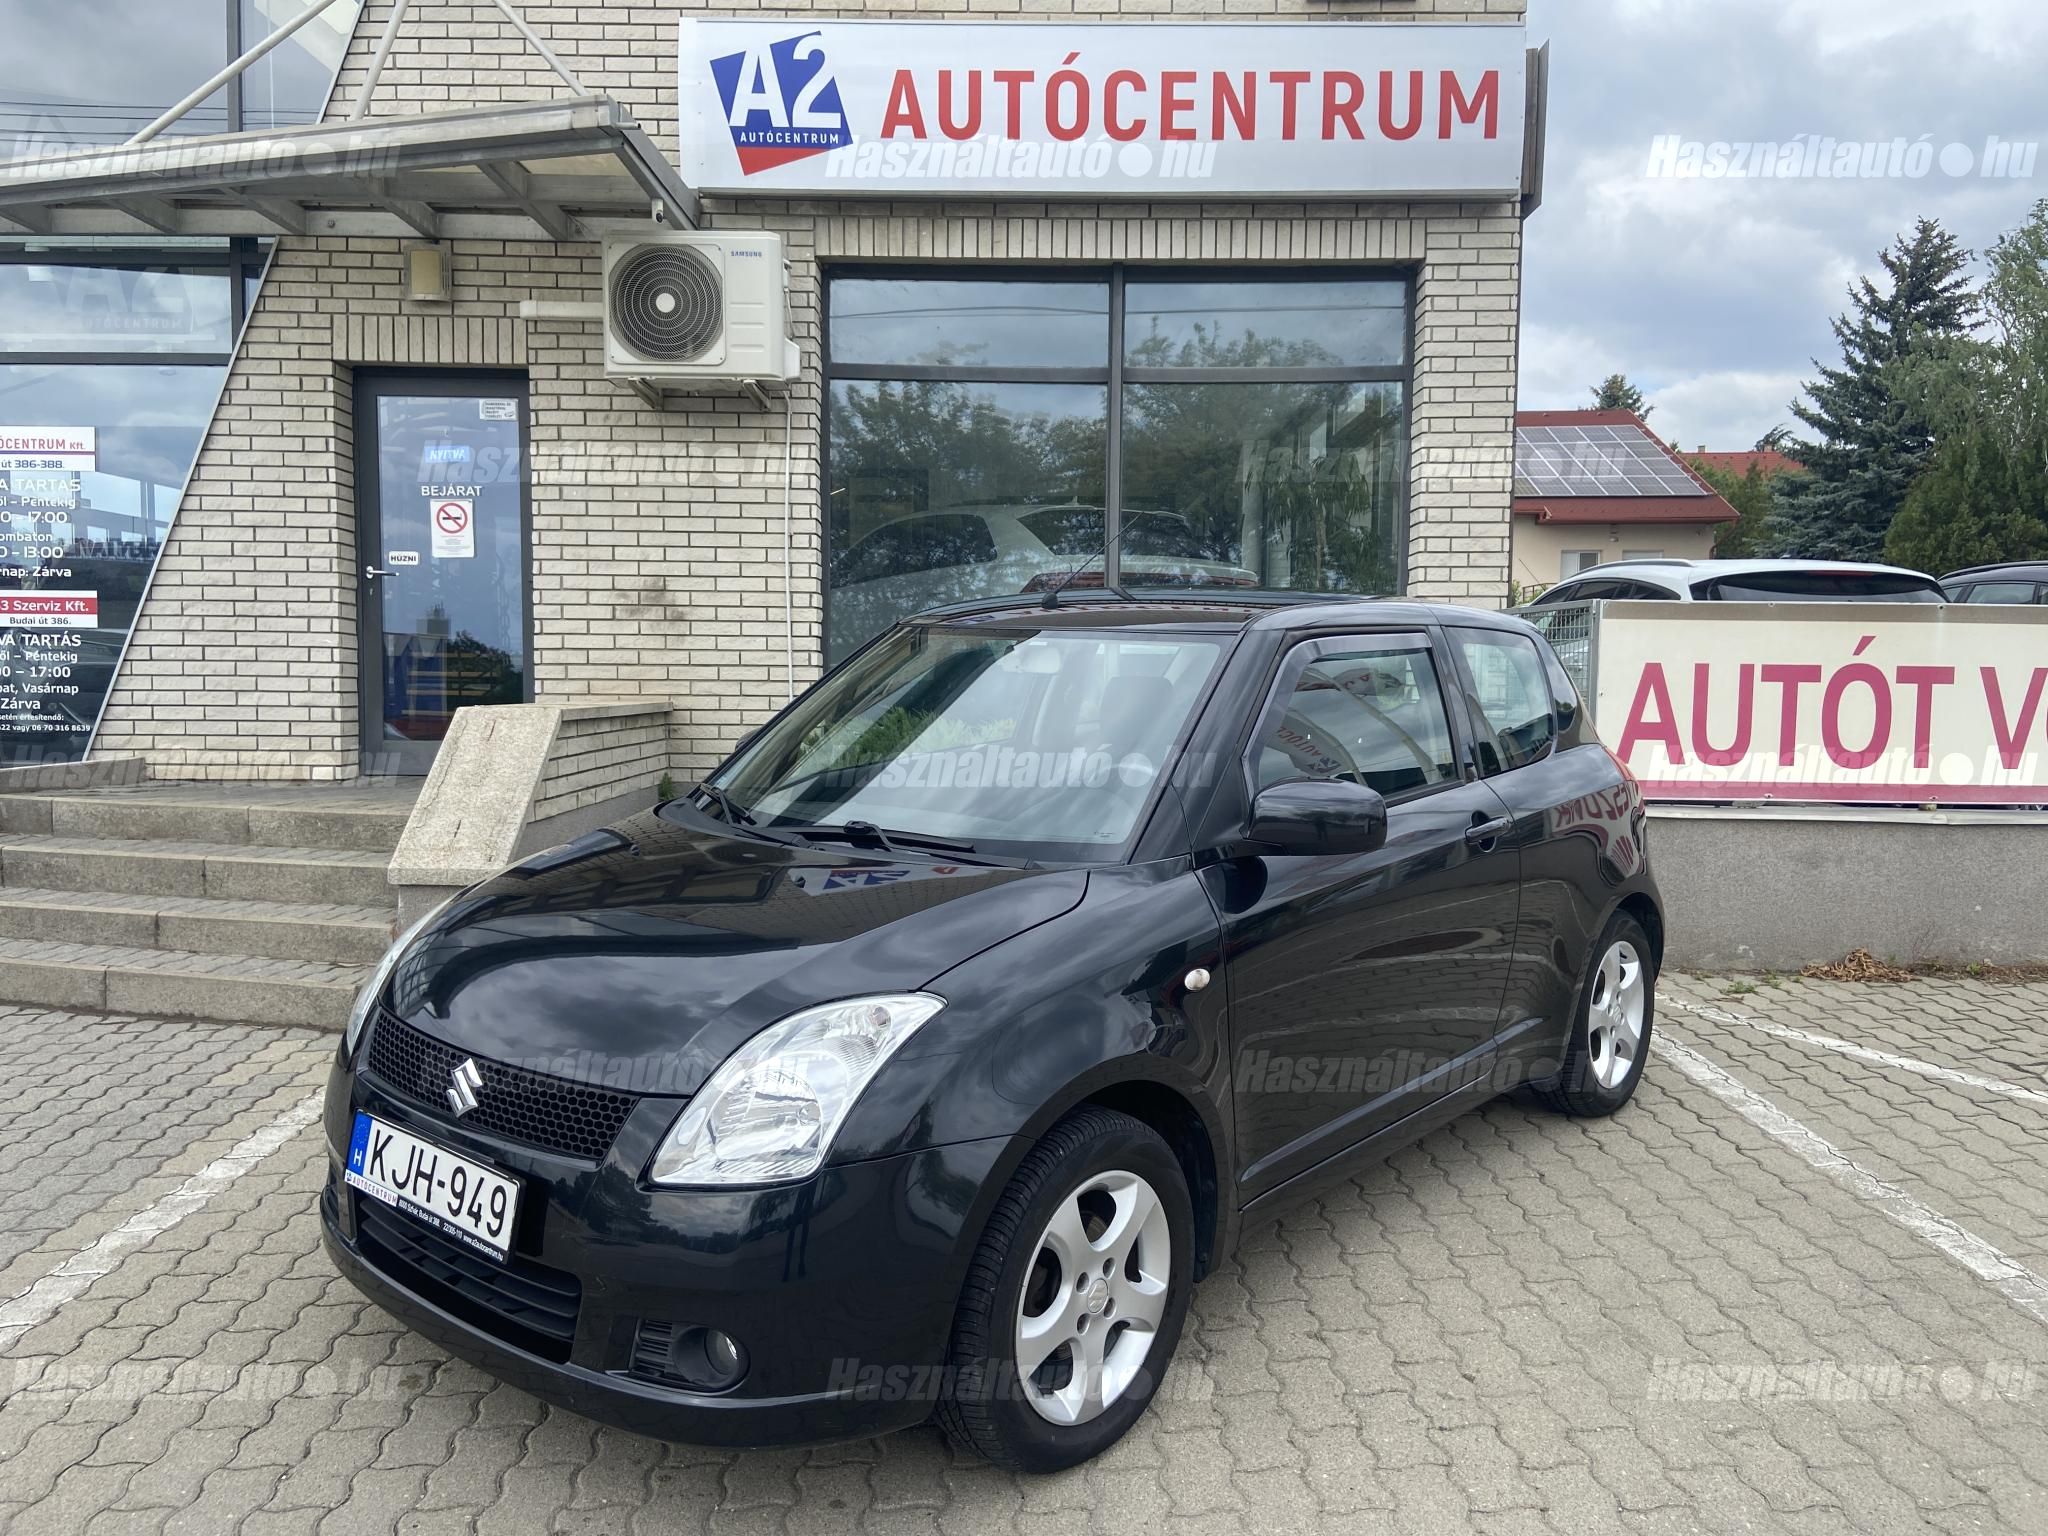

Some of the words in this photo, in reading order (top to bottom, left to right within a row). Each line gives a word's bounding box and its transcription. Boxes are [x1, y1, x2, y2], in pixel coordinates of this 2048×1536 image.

[729, 34, 841, 128] A2
[880, 52, 1498, 141] AUTÓCENTRUM
[740, 130, 839, 144] AUTÓCENTRUM
[421, 483, 482, 496] BEJÁRAT
[28, 511, 68, 523] 17:00
[23, 546, 64, 558] 13:00
[33, 566, 72, 577] Zárva
[13, 600, 61, 611] Szerviz
[65, 600, 89, 612] Kft.
[10, 616, 36, 625] Budai
[39, 616, 48, 625] út
[51, 616, 72, 625] 386.
[22, 631, 82, 647] TARTÁS
[25, 650, 79, 663] Péntekig
[30, 666, 71, 678] 17:00
[22, 682, 79, 695] Vasárnap
[1, 697, 41, 709] Zárva
[1614, 635, 1956, 770] AUTÓT
[353, 1148, 362, 1167] H
[368, 1128, 508, 1239] KJH-949
